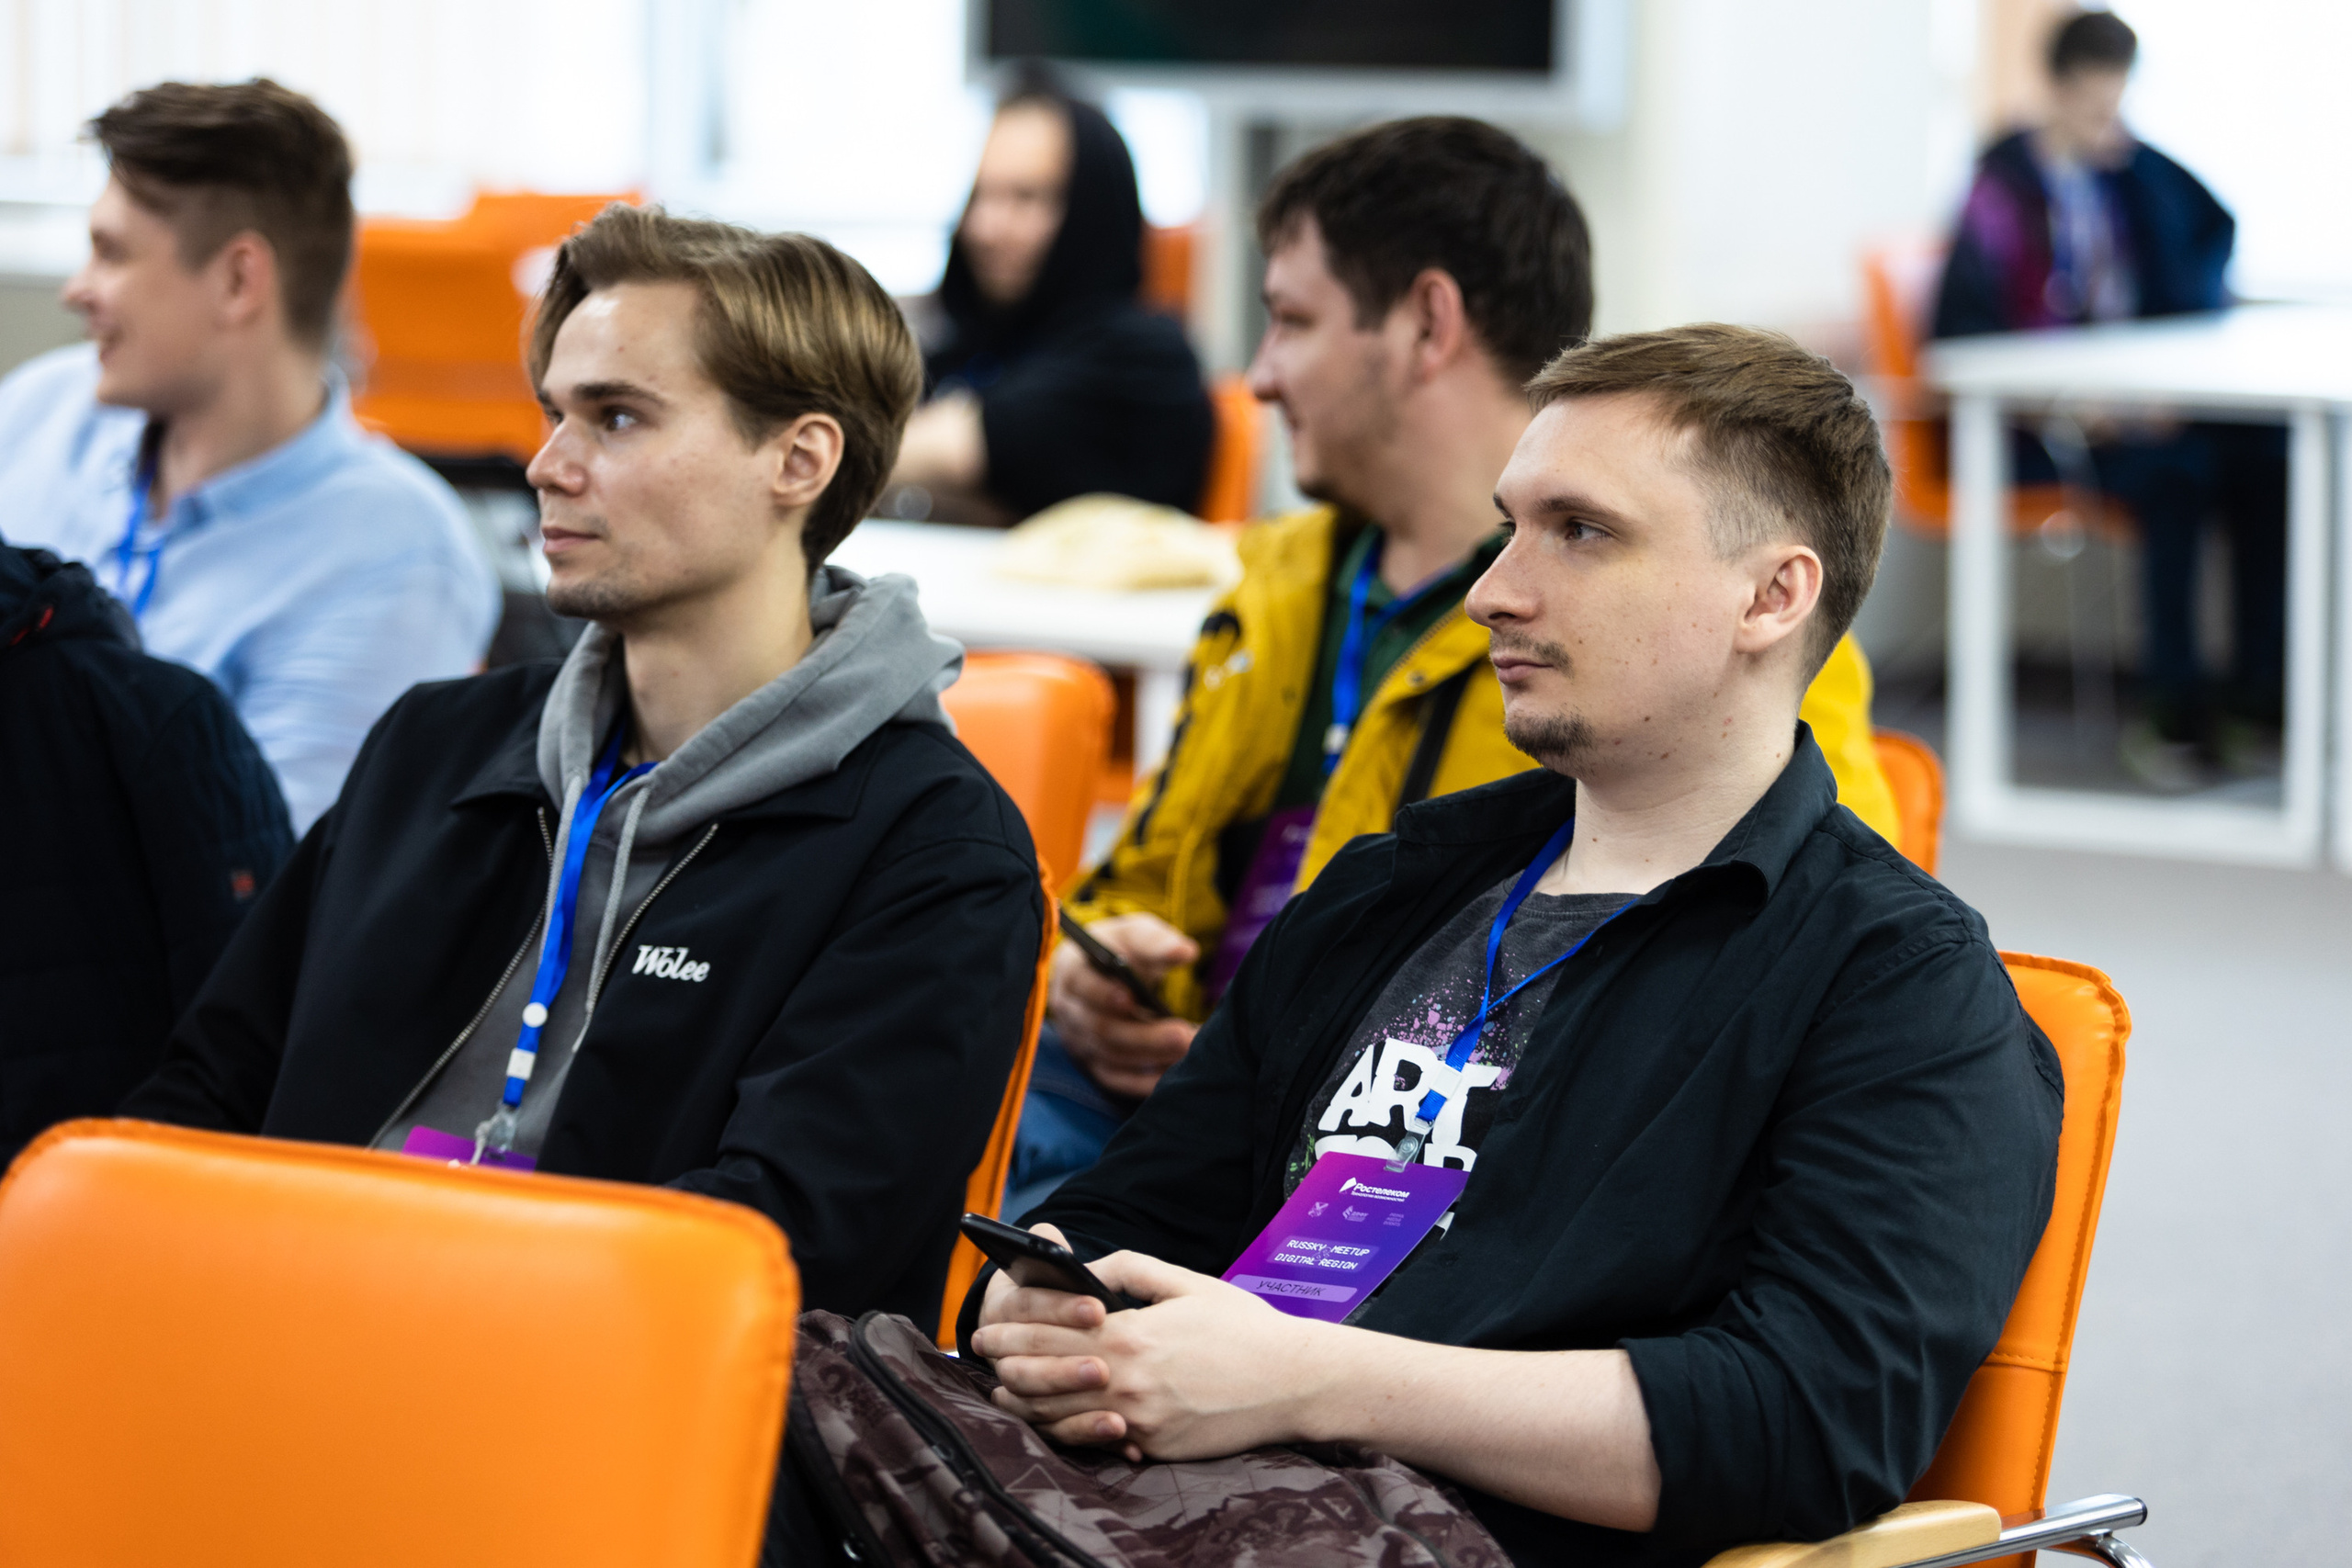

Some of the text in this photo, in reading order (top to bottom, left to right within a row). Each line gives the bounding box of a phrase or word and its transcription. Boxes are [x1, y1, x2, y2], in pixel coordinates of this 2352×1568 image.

[631, 944, 711, 982] Wolee
[1318, 1037, 1502, 1145] ART
[1353, 1182, 1410, 1198] Ростелеком
[1286, 1239, 1371, 1257] RUSSKY MEETUP
[1274, 1253, 1358, 1270] DIGITAL REGION
[1256, 1280, 1327, 1297] УЧАСТНИК
